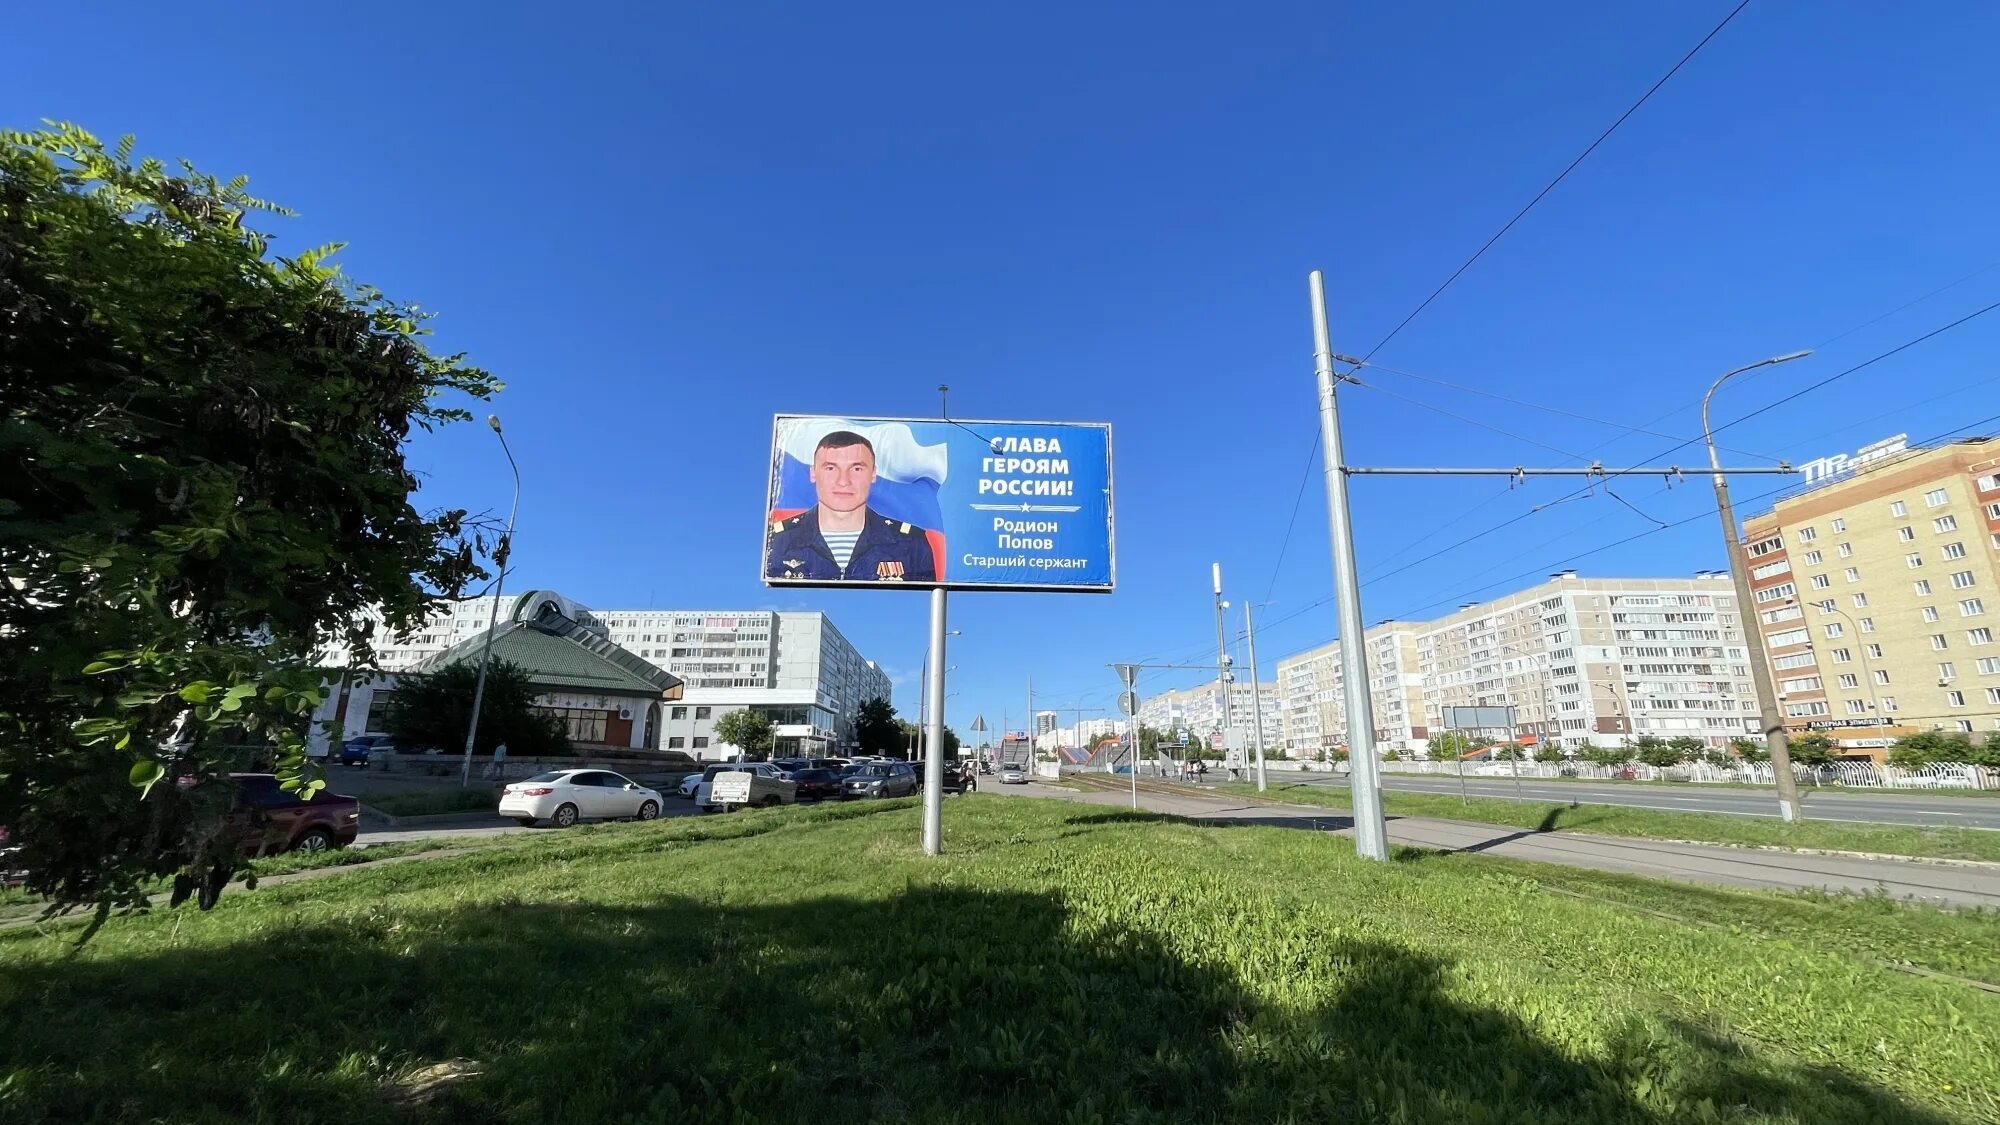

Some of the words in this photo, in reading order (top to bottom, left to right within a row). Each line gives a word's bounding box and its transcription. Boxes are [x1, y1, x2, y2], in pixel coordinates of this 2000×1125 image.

[990, 437, 1061, 453] СЛАВА
[983, 458, 1069, 474] ГЕРОЯМ
[979, 479, 1073, 496] РОССИИ!
[993, 517, 1058, 534] Родион
[998, 534, 1053, 550] Попов
[963, 553, 1026, 569] Старший
[1029, 558, 1088, 570] сержант
[1810, 720, 1847, 729] ЛАЗЕРНАЯ
